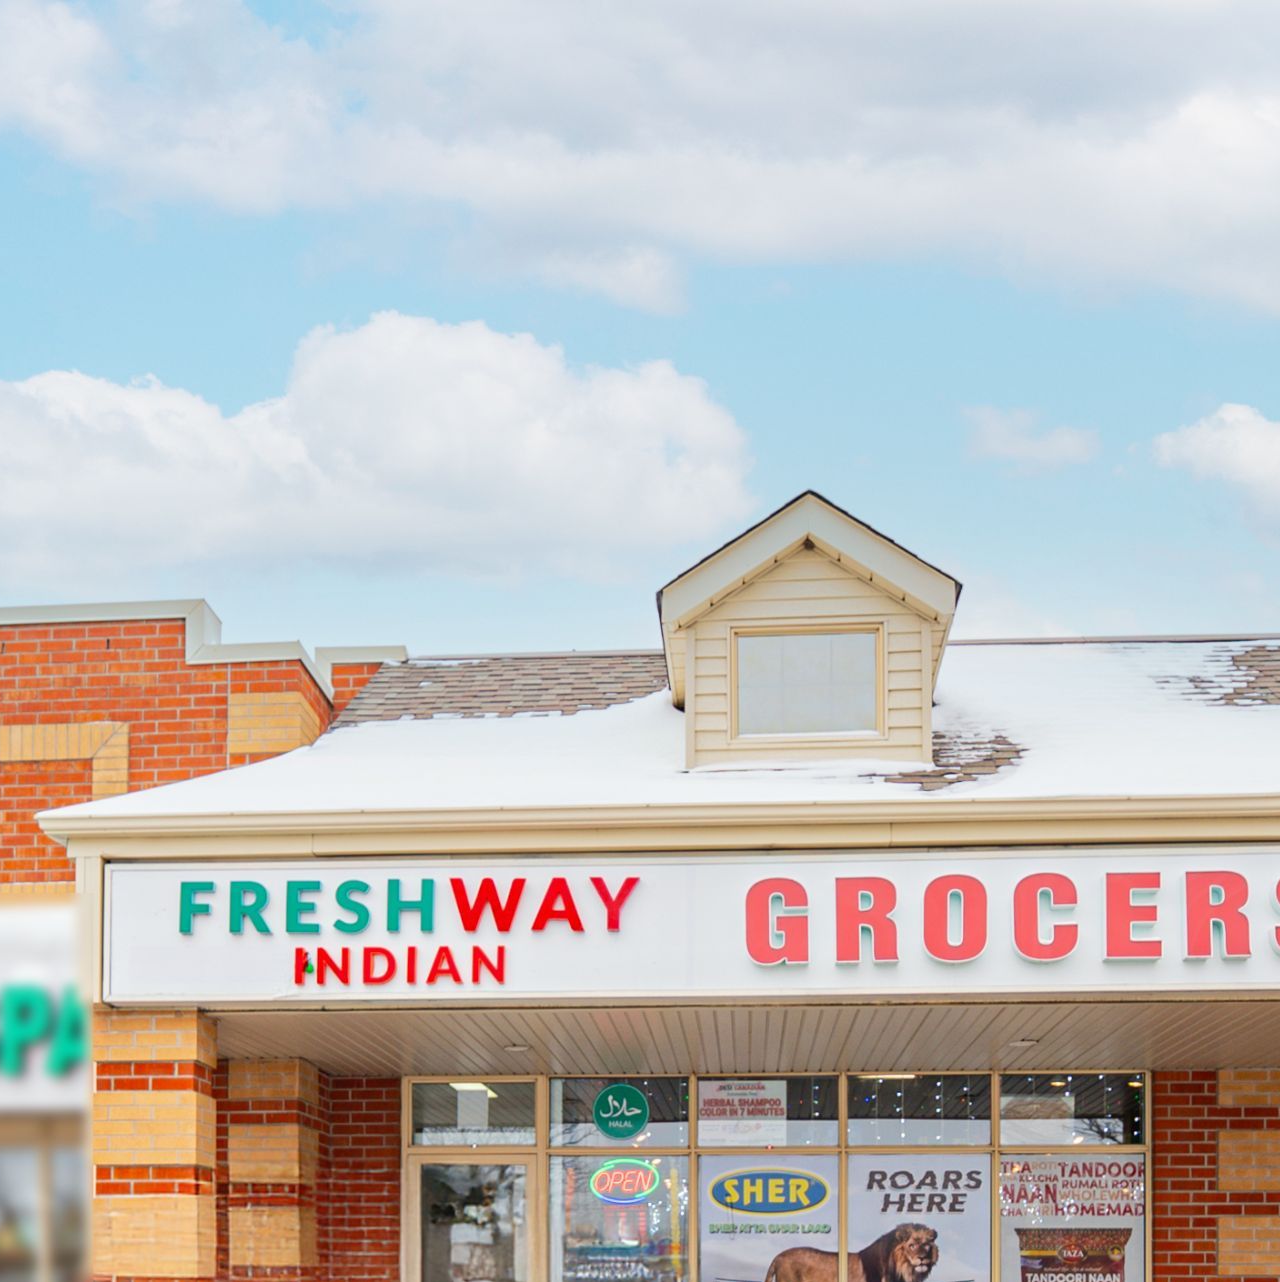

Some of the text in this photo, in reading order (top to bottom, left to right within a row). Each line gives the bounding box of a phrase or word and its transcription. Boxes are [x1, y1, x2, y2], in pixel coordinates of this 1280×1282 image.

[178, 876, 640, 936] FRESHWAY
[294, 945, 506, 986] INDIAN
[599, 1095, 642, 1118] حلال
[700, 1107, 785, 1116] COLOR IN 7 MINUTES
[703, 1098, 782, 1107] HERBAL SHAMPOO
[594, 1170, 653, 1193] OPEN
[867, 1170, 982, 1190] ROARS
[1019, 1174, 1058, 1182] KULCHA
[1062, 1180, 1108, 1189] RUMALI
[723, 1177, 811, 1206] SHER
[1002, 1183, 1057, 1203] NAAN
[881, 1193, 967, 1213] HERE
[709, 1223, 737, 1234] SHER
[1063, 1250, 1084, 1258] TAZA
